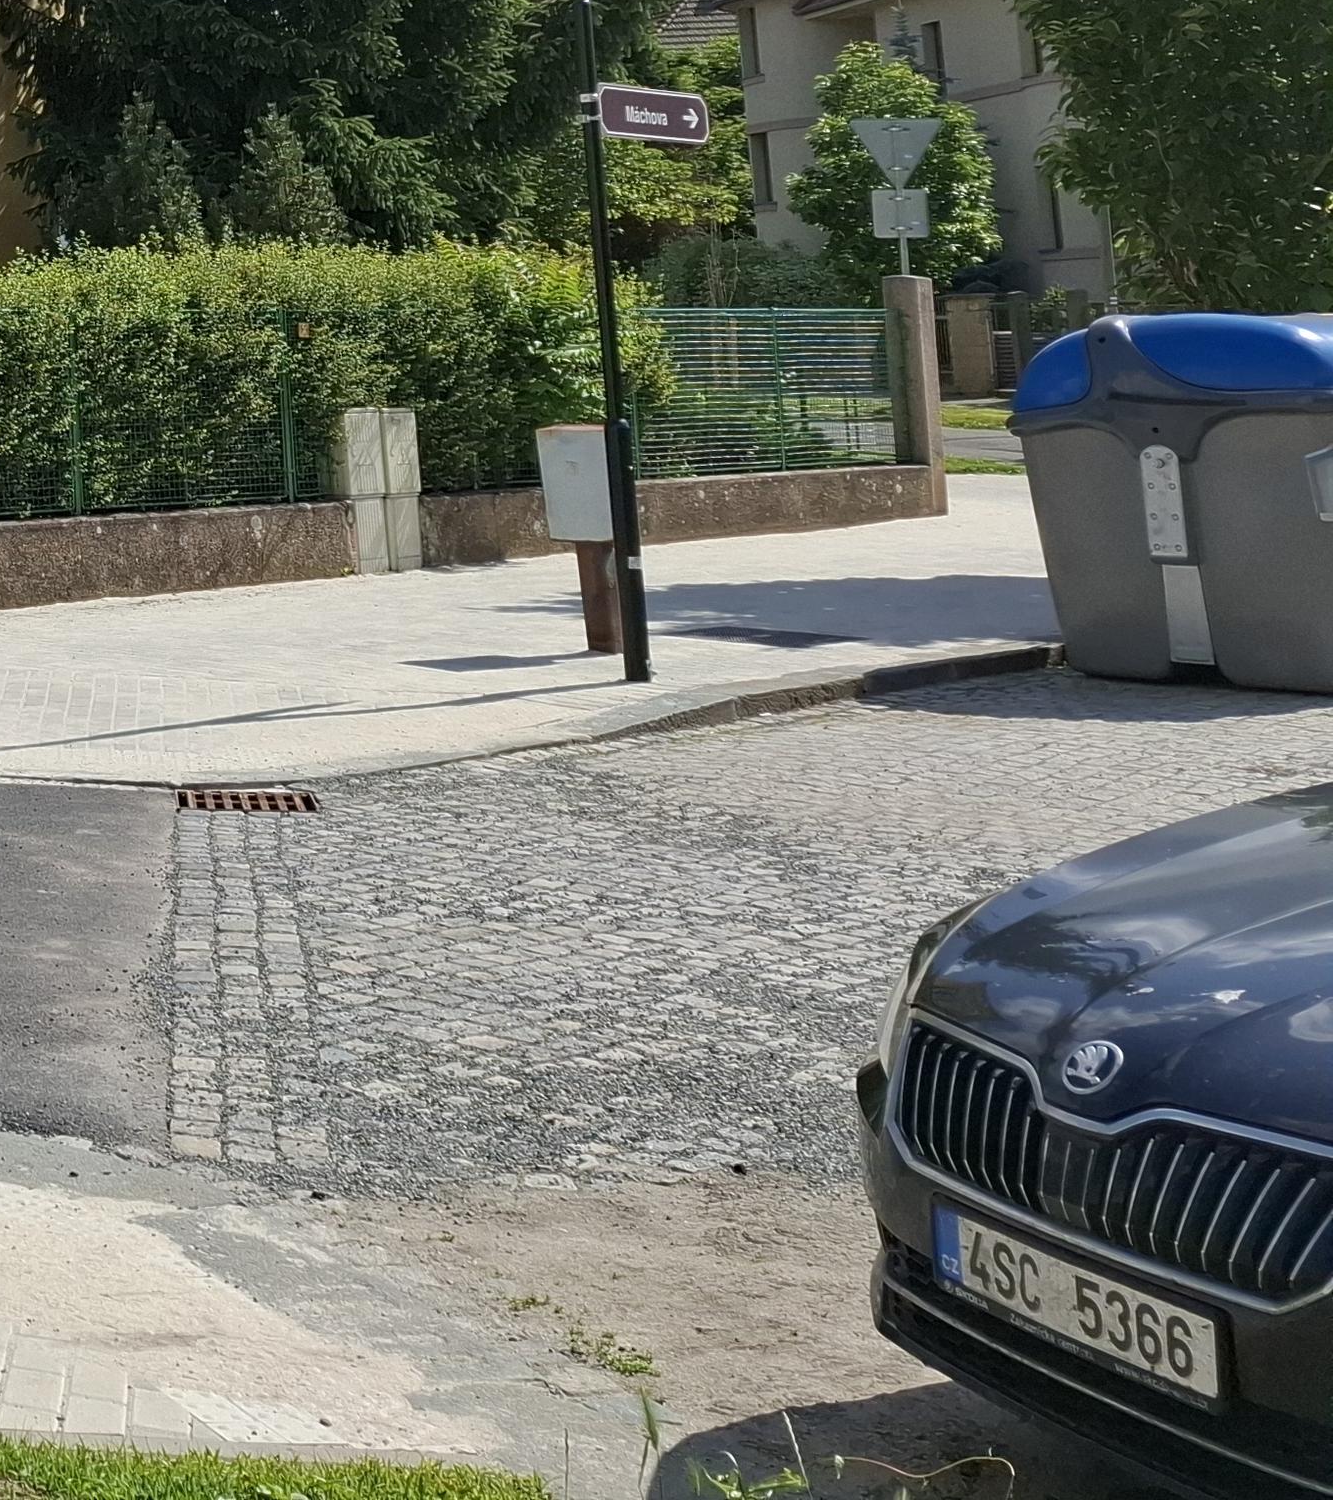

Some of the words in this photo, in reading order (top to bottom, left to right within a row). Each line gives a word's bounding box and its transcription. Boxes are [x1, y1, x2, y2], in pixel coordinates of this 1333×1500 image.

[625, 105, 668, 126] Máchova
[941, 1253, 960, 1276] CZ
[969, 1231, 1041, 1312] 4SC
[1074, 1274, 1194, 1378] 5366
